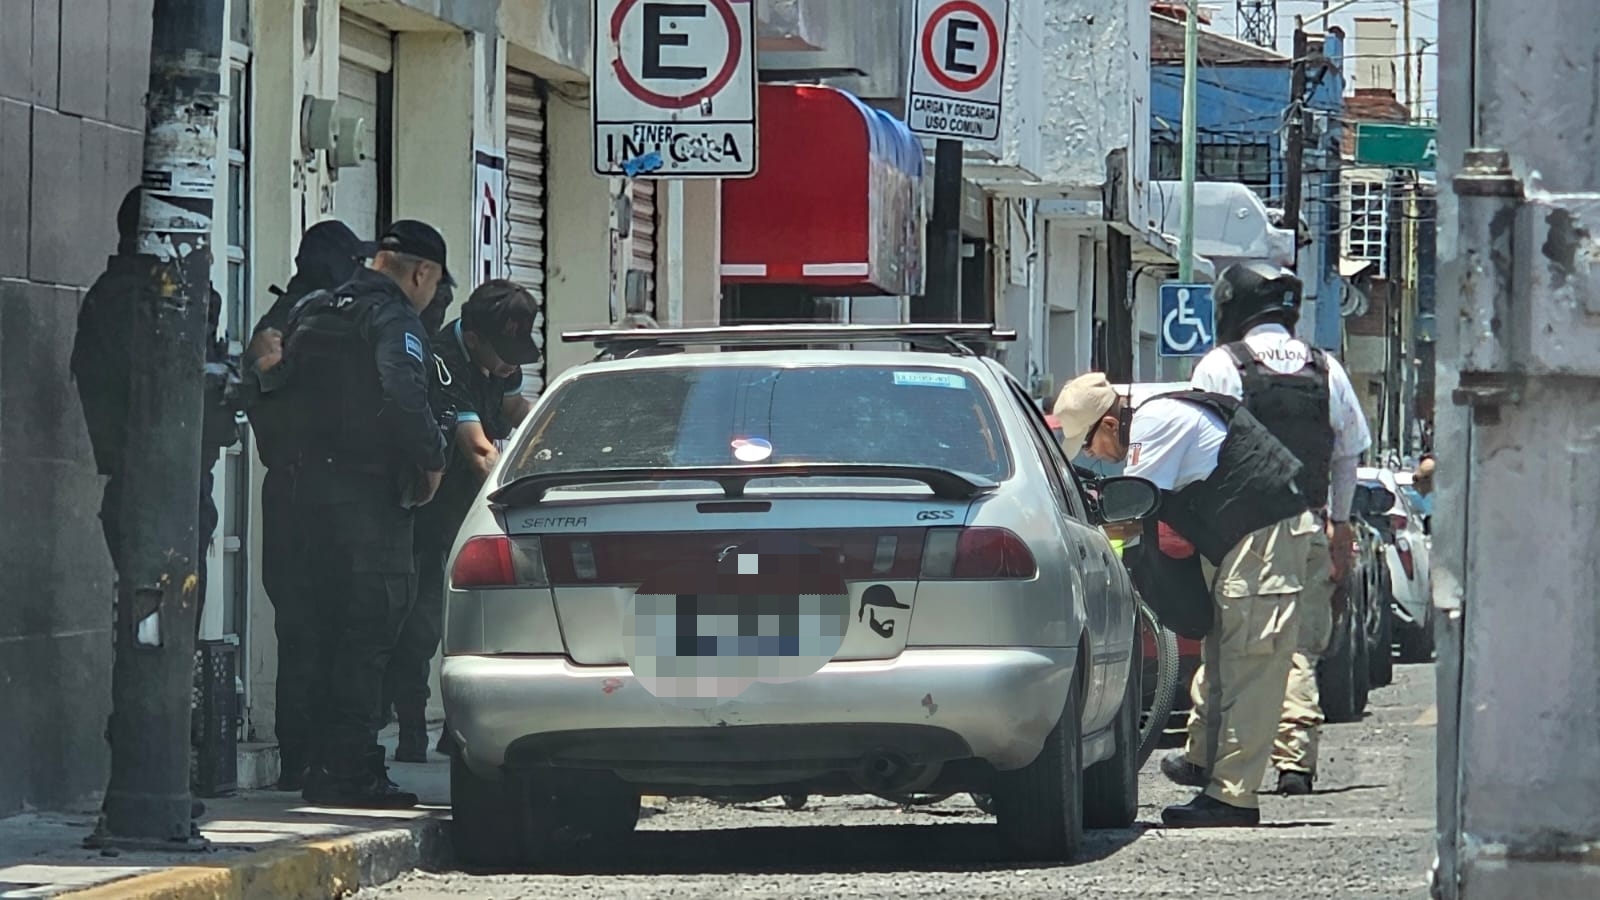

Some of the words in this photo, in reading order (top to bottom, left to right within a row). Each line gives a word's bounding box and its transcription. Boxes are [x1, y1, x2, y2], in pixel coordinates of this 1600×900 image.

[642, 3, 708, 79] E
[945, 18, 979, 75] E
[914, 98, 944, 112] CARGA
[944, 104, 952, 115] Y
[954, 104, 995, 119] DESCARGA
[926, 116, 947, 128] USO
[521, 516, 588, 529] SENTRA
[916, 510, 955, 521] GSS
